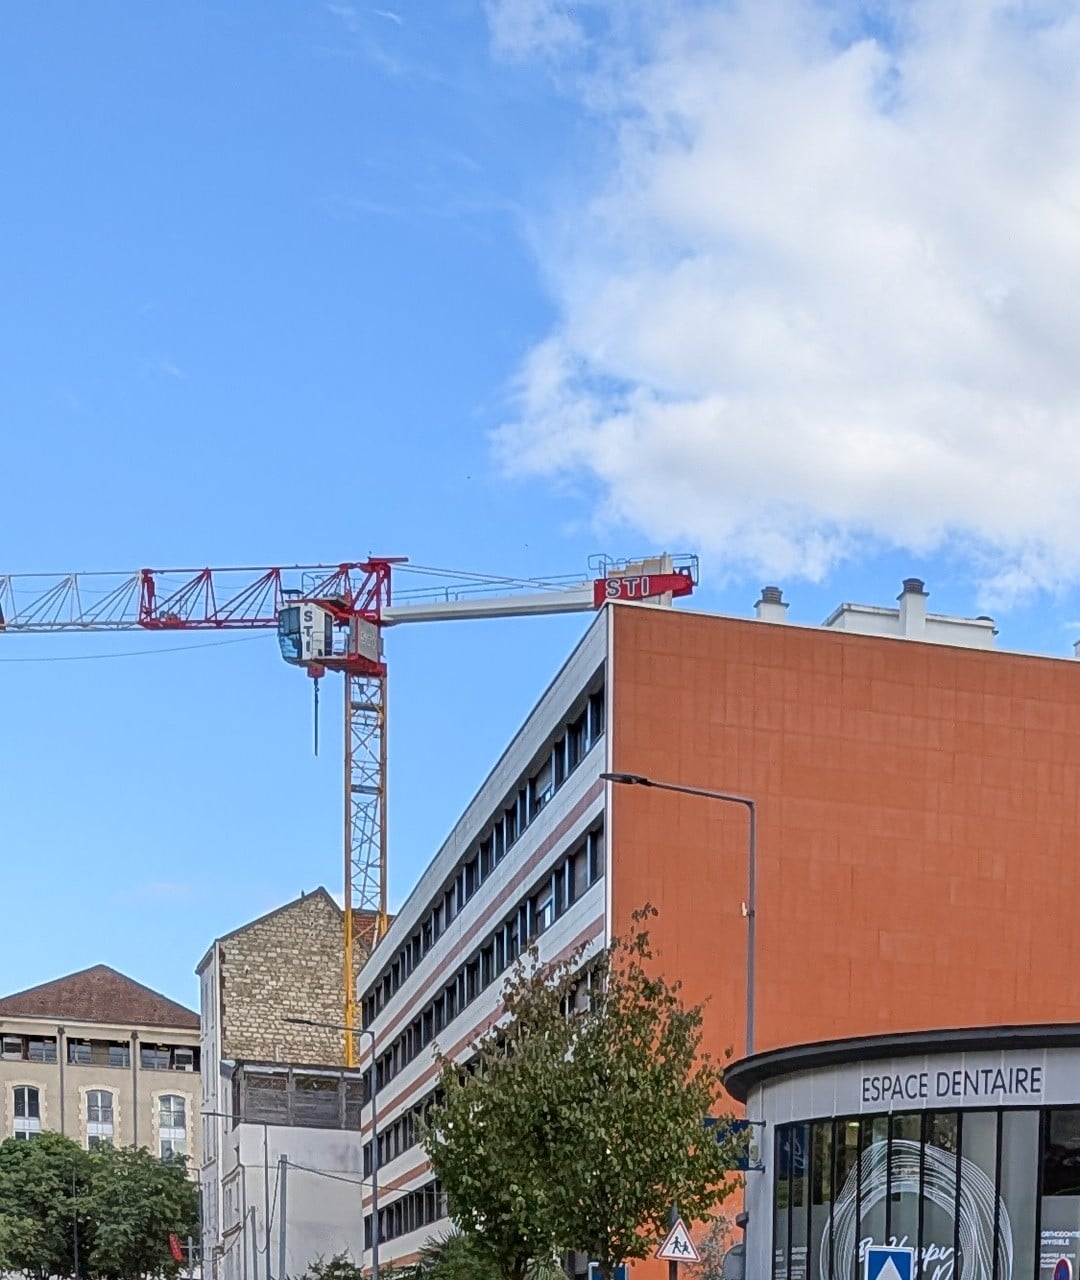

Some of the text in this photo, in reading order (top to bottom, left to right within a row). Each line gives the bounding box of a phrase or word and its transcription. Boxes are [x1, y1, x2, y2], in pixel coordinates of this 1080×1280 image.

[605, 577, 650, 598] STI
[303, 610, 314, 653] STI
[862, 1067, 1042, 1102] ESPACE DENTAIRE
